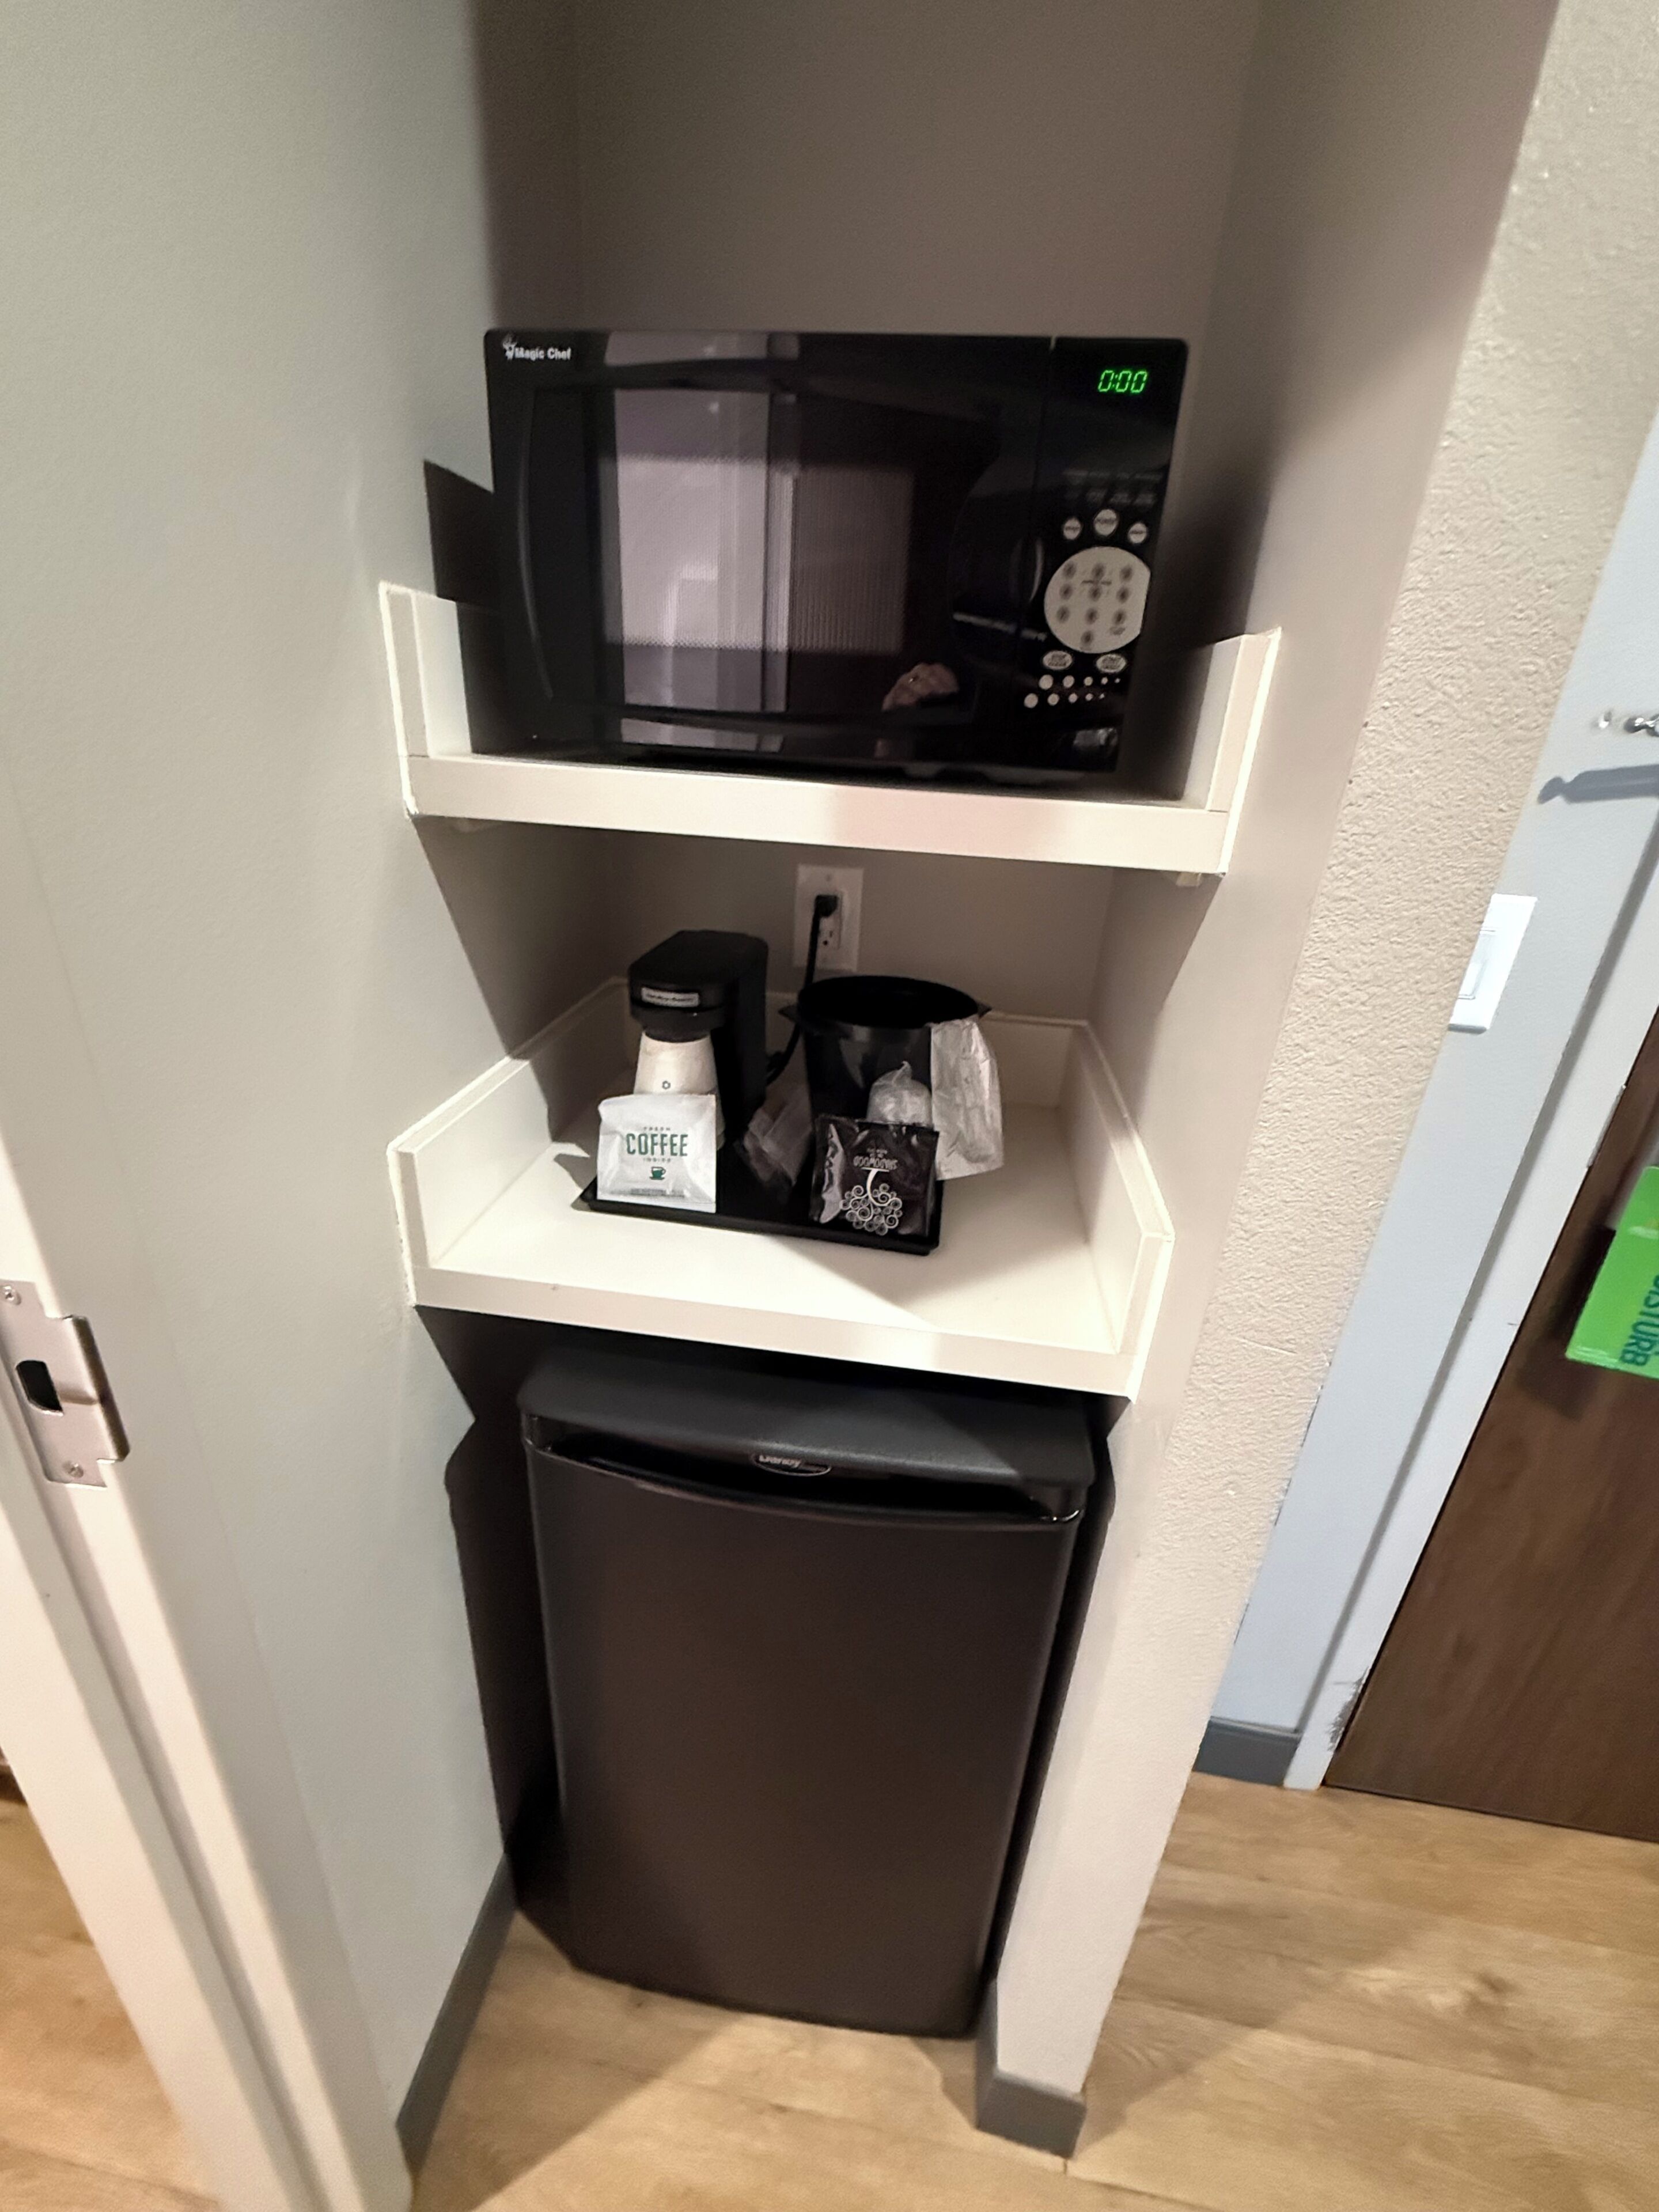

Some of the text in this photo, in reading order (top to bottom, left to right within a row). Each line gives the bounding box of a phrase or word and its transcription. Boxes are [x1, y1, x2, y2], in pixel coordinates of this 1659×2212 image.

[515, 347, 571, 361] Magic Chef
[1097, 370, 1147, 393] 0:00
[626, 1133, 688, 1156] COFFEE
[1619, 1275, 1659, 1366] STURB
